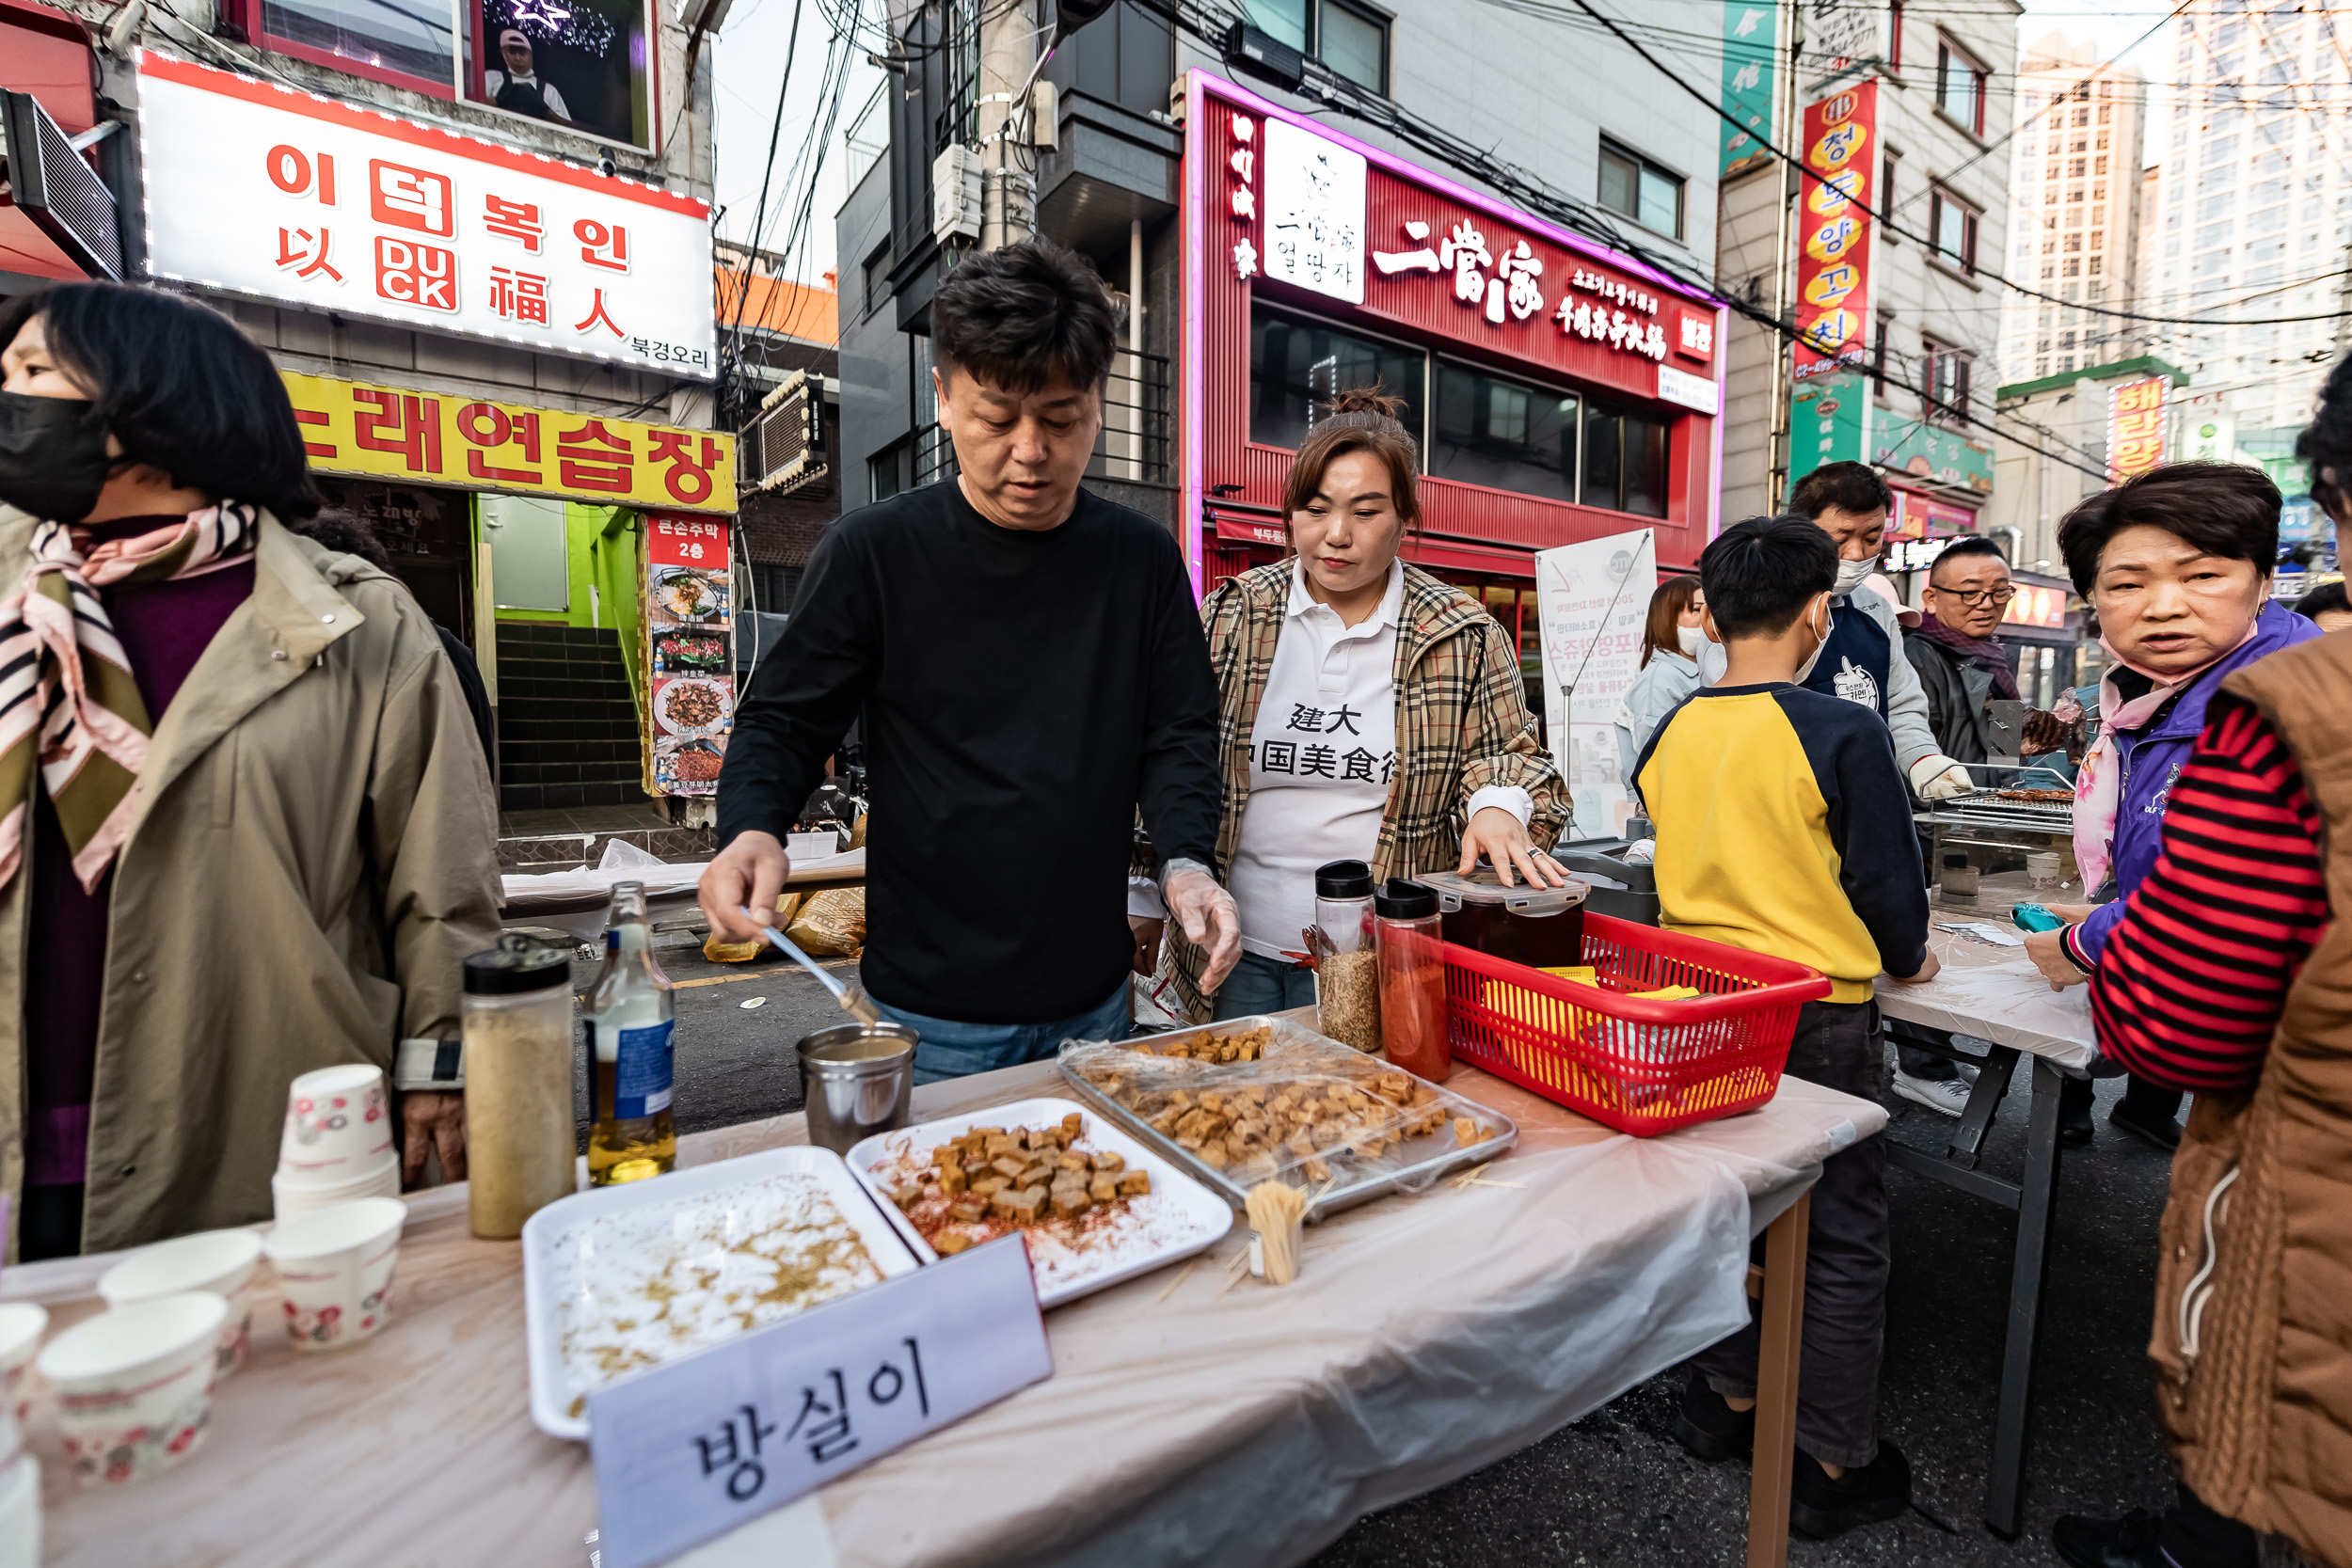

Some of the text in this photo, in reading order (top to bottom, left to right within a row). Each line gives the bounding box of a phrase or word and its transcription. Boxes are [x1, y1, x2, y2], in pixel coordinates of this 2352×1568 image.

[275, 227, 343, 282] 以
[631, 337, 707, 369] 북경오리
[658, 519, 719, 539] 큰손주막
[678, 543, 705, 559] 2층
[1285, 702, 1362, 736] 建大
[693, 1335, 930, 1503] 방실이
